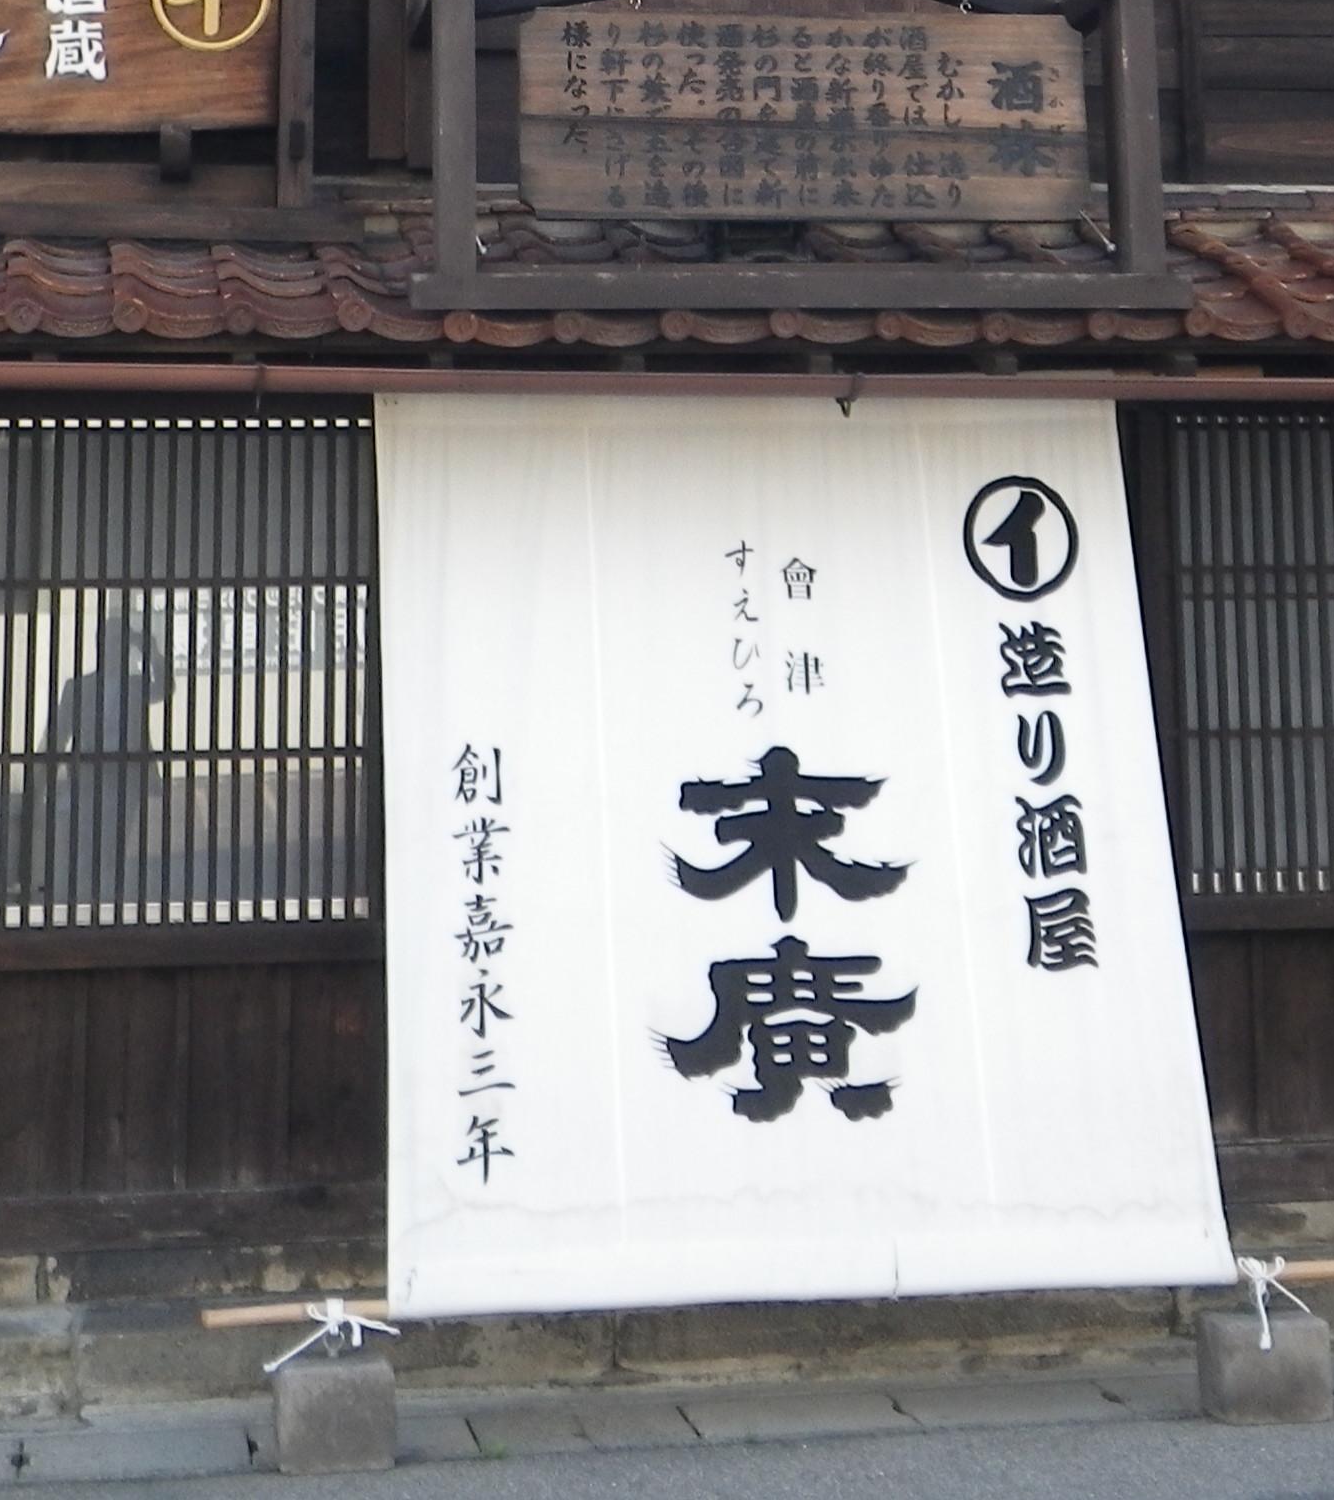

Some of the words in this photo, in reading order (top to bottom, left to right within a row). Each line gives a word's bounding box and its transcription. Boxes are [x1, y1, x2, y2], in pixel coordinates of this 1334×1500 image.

[725, 541, 764, 716] すえひろ
[780, 558, 825, 694] 會津
[998, 622, 1099, 971] 造り酒屋
[451, 743, 516, 1185] 創業嘉永三年
[650, 746, 919, 1123] 末廣
